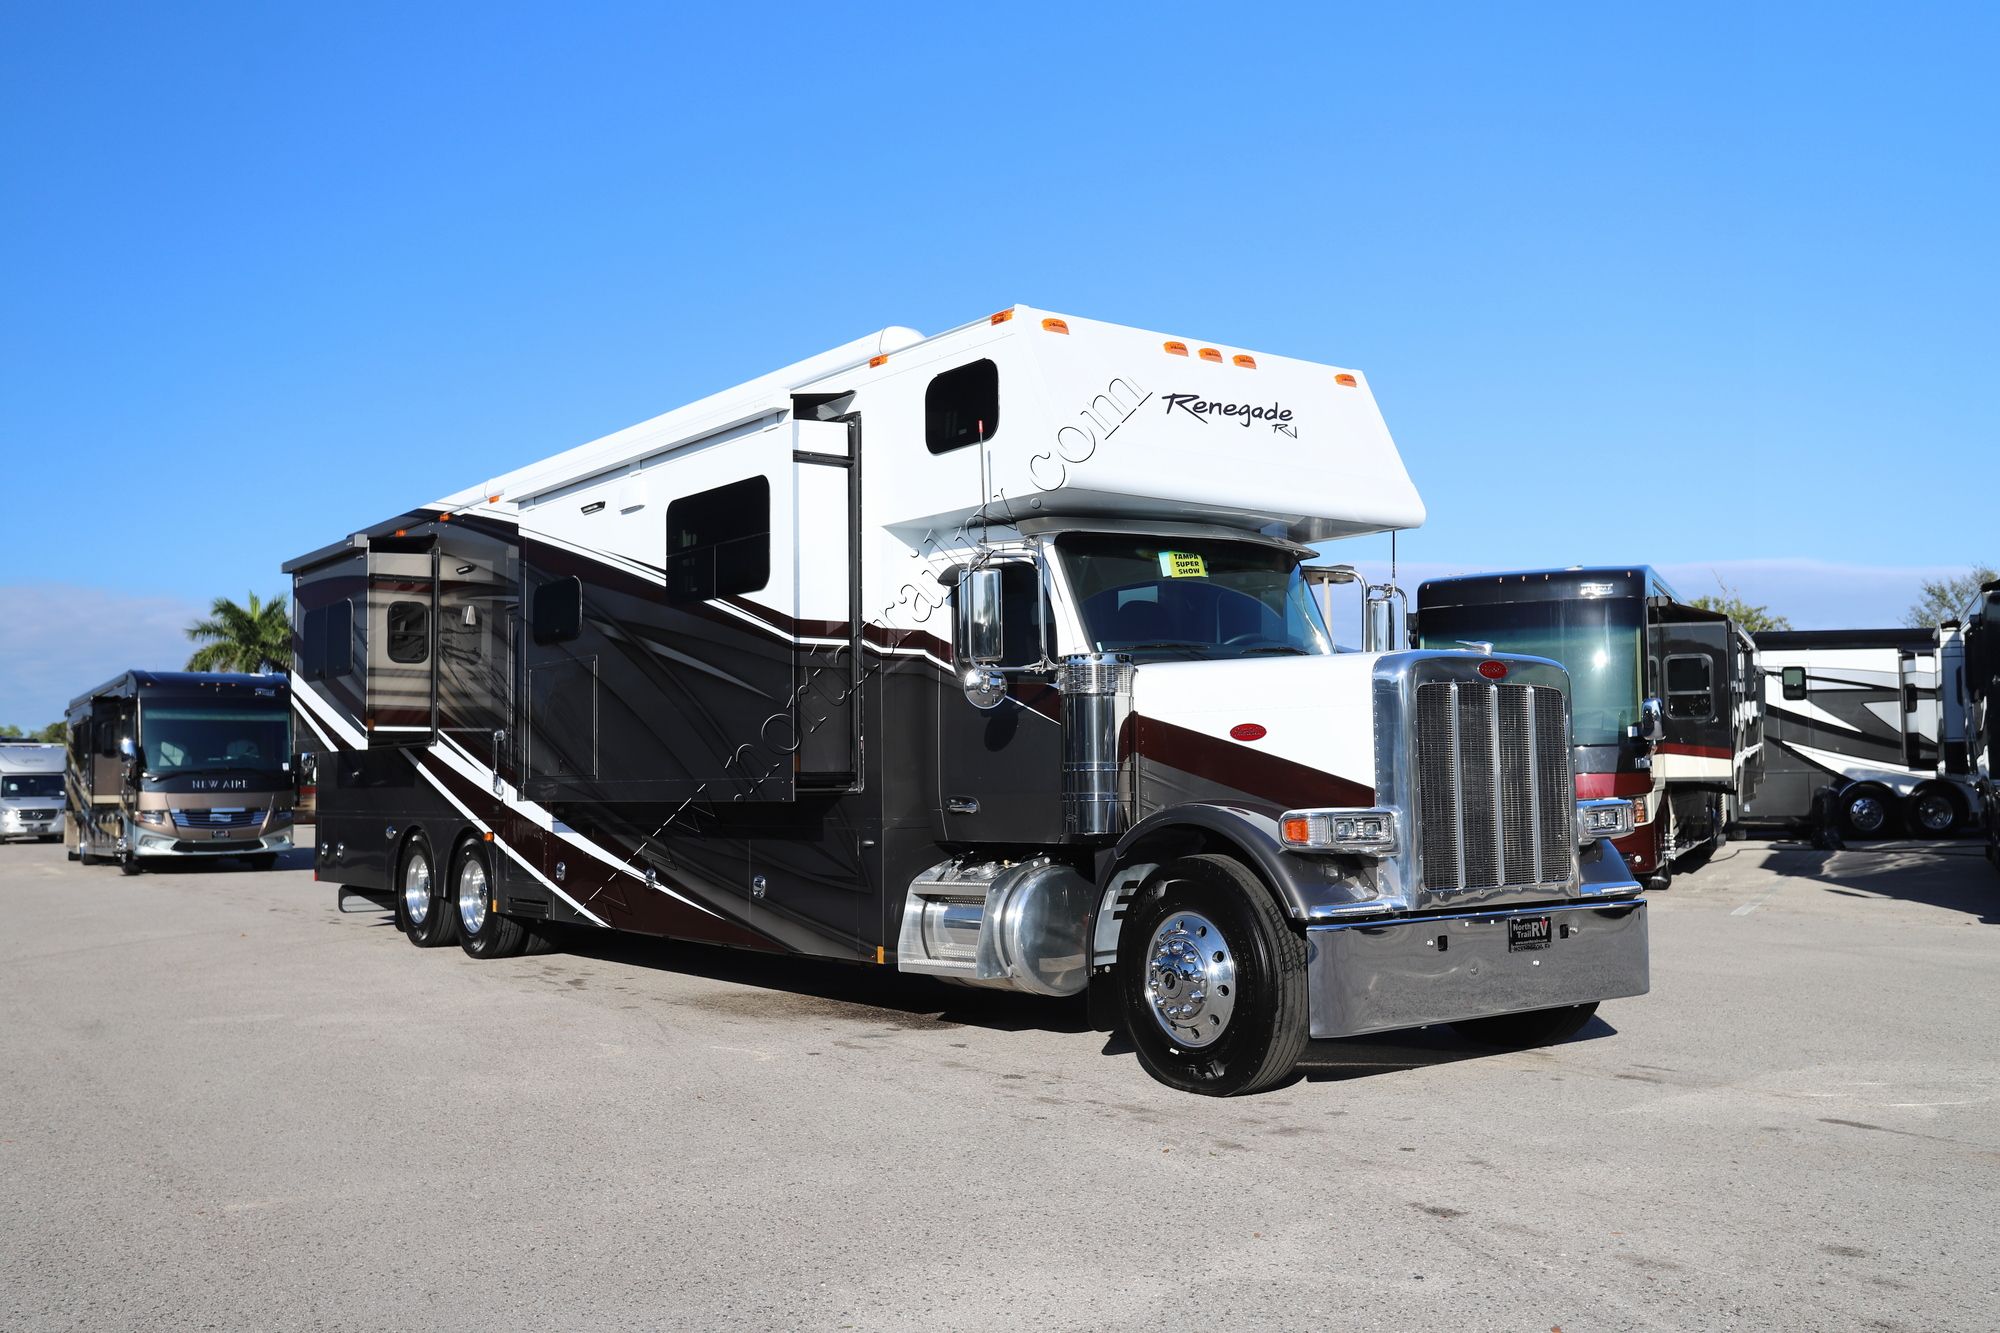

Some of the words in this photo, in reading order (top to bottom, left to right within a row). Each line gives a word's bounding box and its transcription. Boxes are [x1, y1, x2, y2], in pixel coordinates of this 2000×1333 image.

[1161, 393, 1293, 427] Renegade
[1271, 423, 1298, 439] RV
[1513, 923, 1531, 931] North
[1531, 920, 1548, 937] RV
